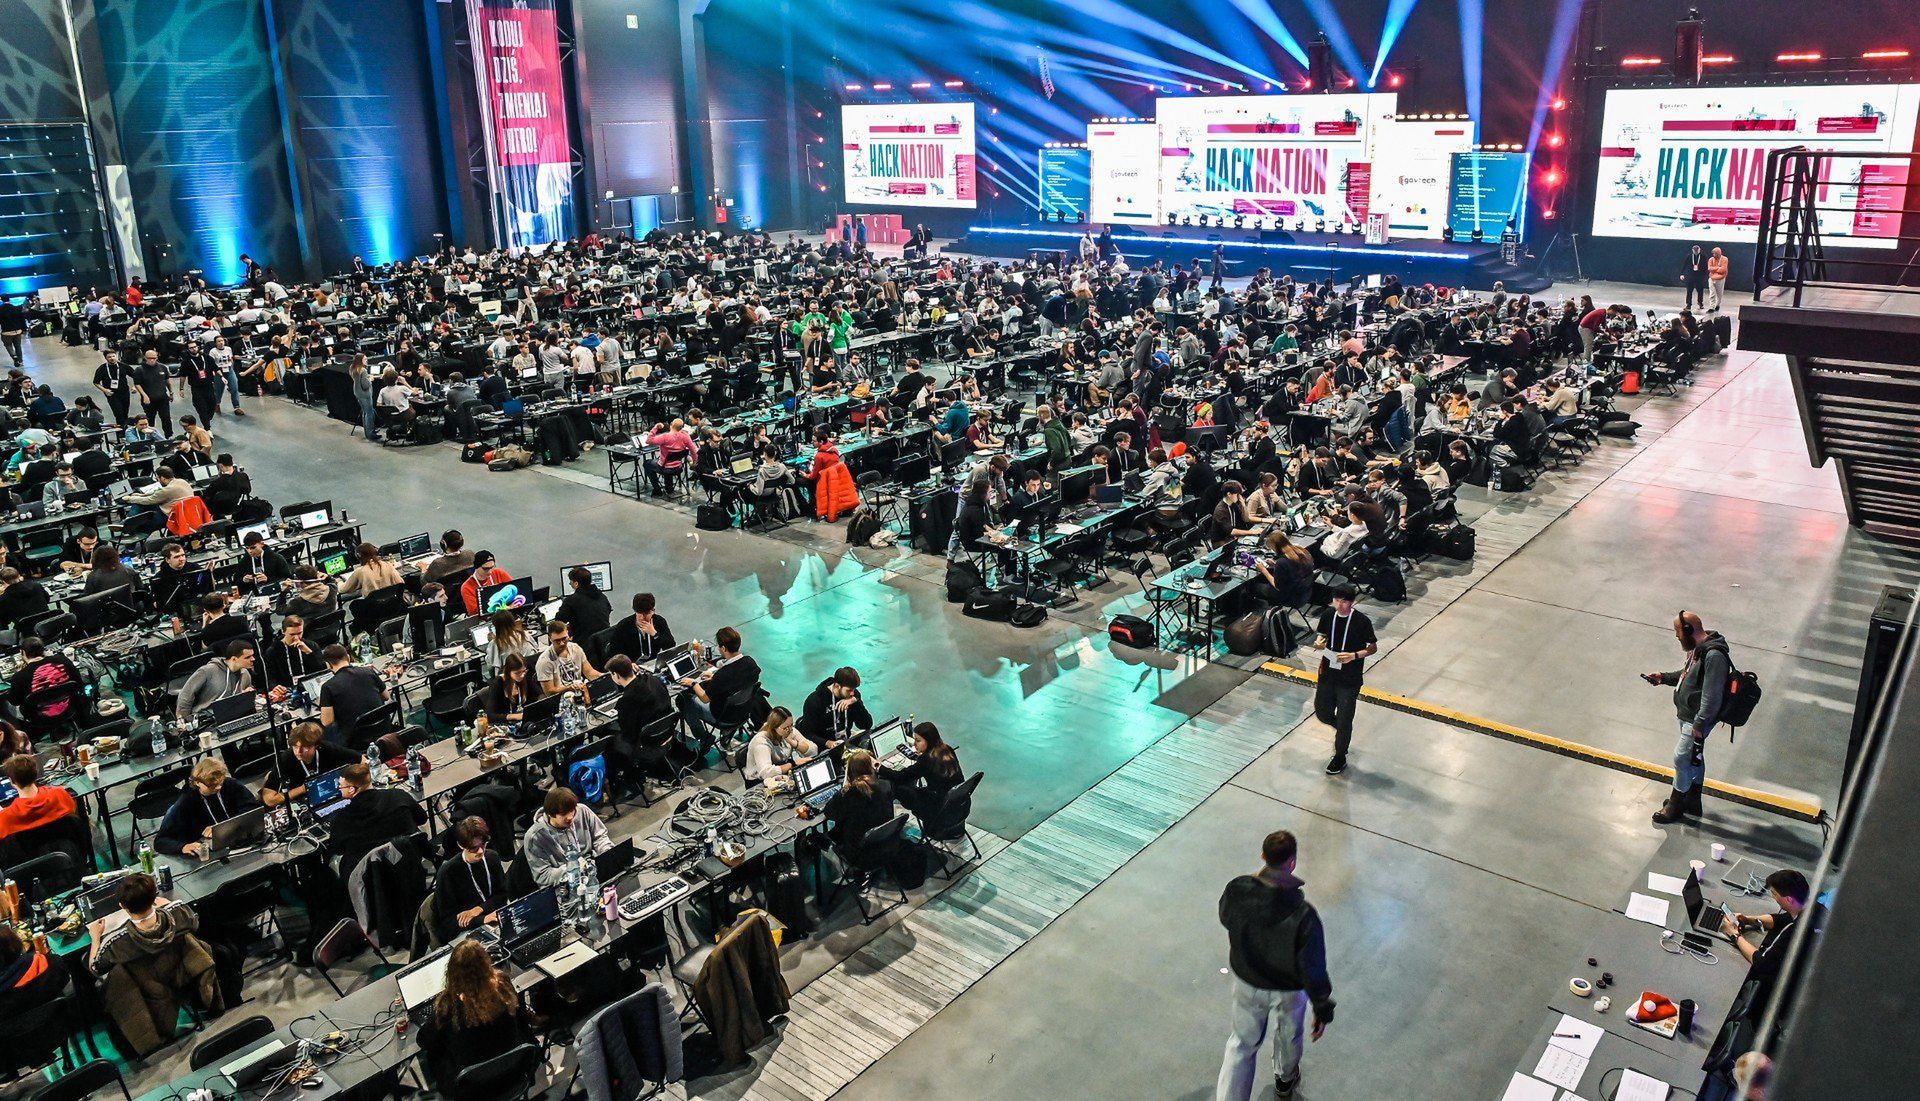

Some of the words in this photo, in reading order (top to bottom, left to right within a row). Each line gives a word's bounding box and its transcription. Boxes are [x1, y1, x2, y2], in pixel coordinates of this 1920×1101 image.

[489, 20, 523, 47] KODUJ
[498, 92, 548, 118] ZMIENIAJ
[503, 127, 538, 154] JUTRO!
[869, 143, 944, 178] HACKNATION
[1205, 147, 1328, 195] HACKNATION
[1654, 147, 1834, 202] HACKNAIN
